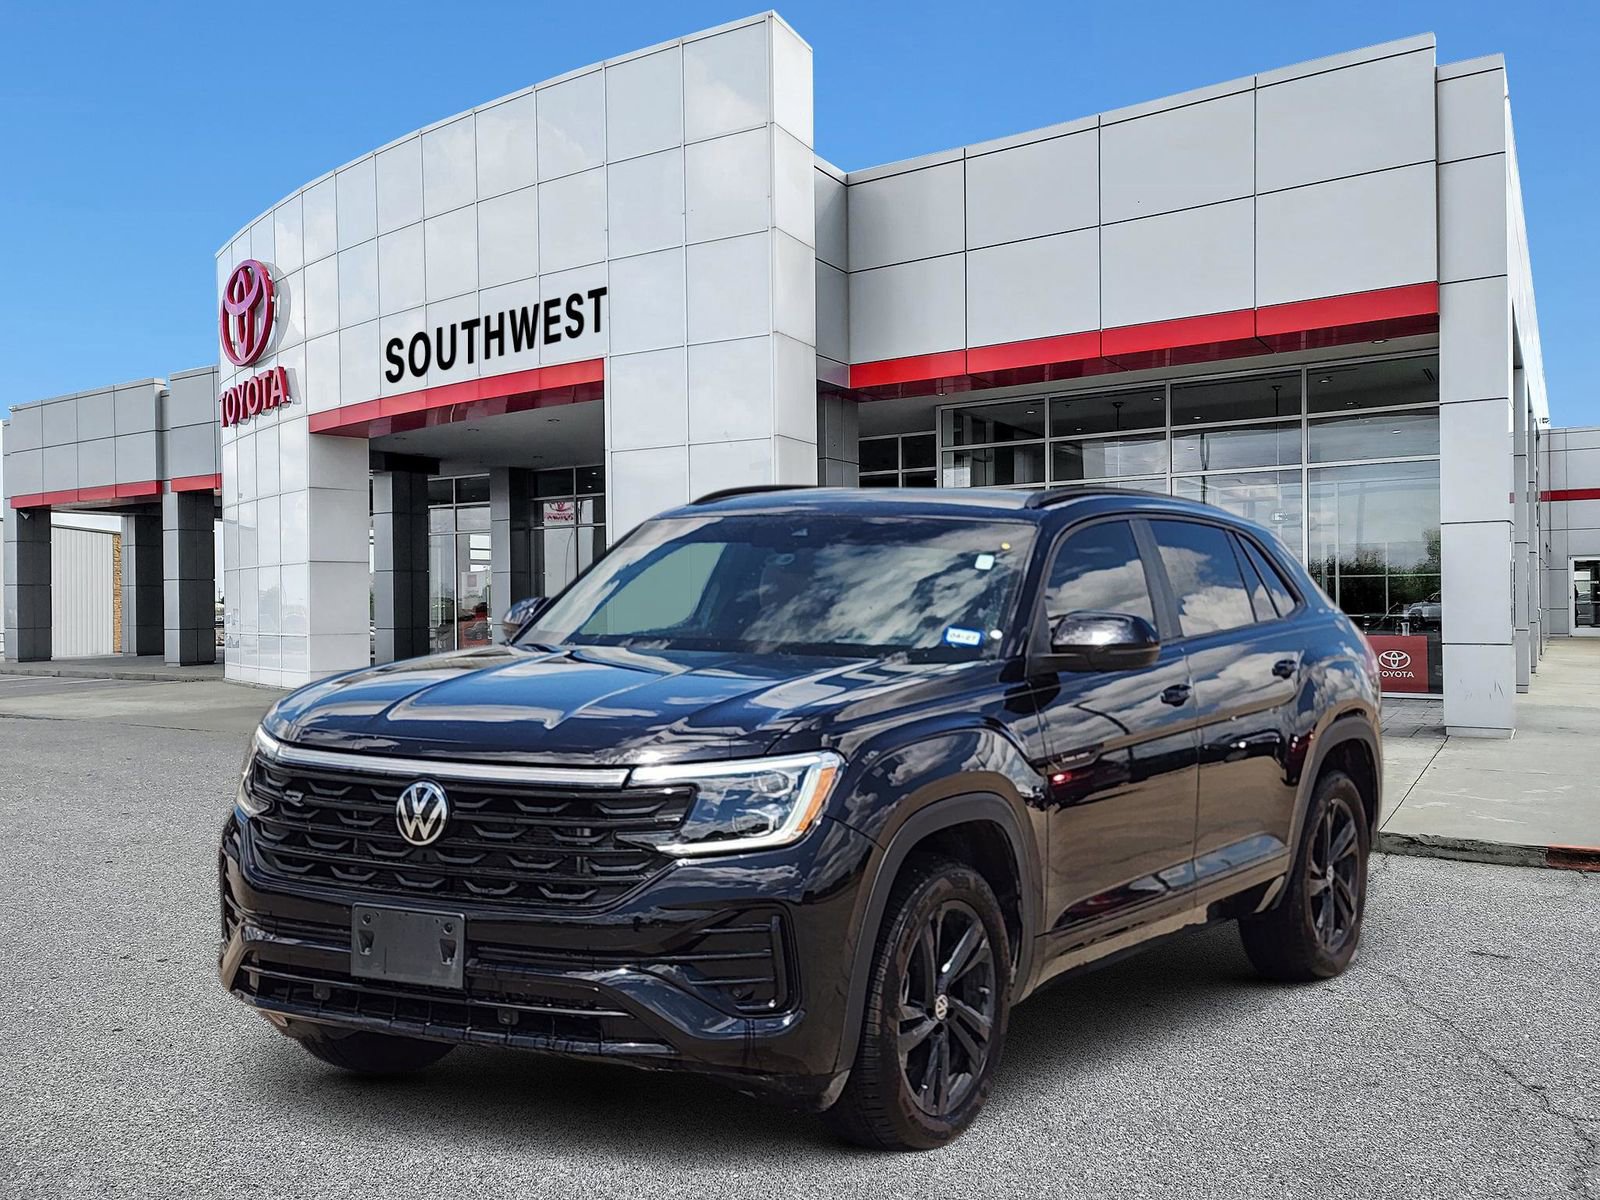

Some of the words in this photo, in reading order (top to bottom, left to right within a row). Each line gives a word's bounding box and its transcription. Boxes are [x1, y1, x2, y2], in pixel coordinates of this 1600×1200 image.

[385, 286, 607, 384] SOUTHWEST
[218, 366, 290, 428] TOYOTA
[1379, 670, 1414, 678] OYOTA
[397, 782, 447, 845] VW
